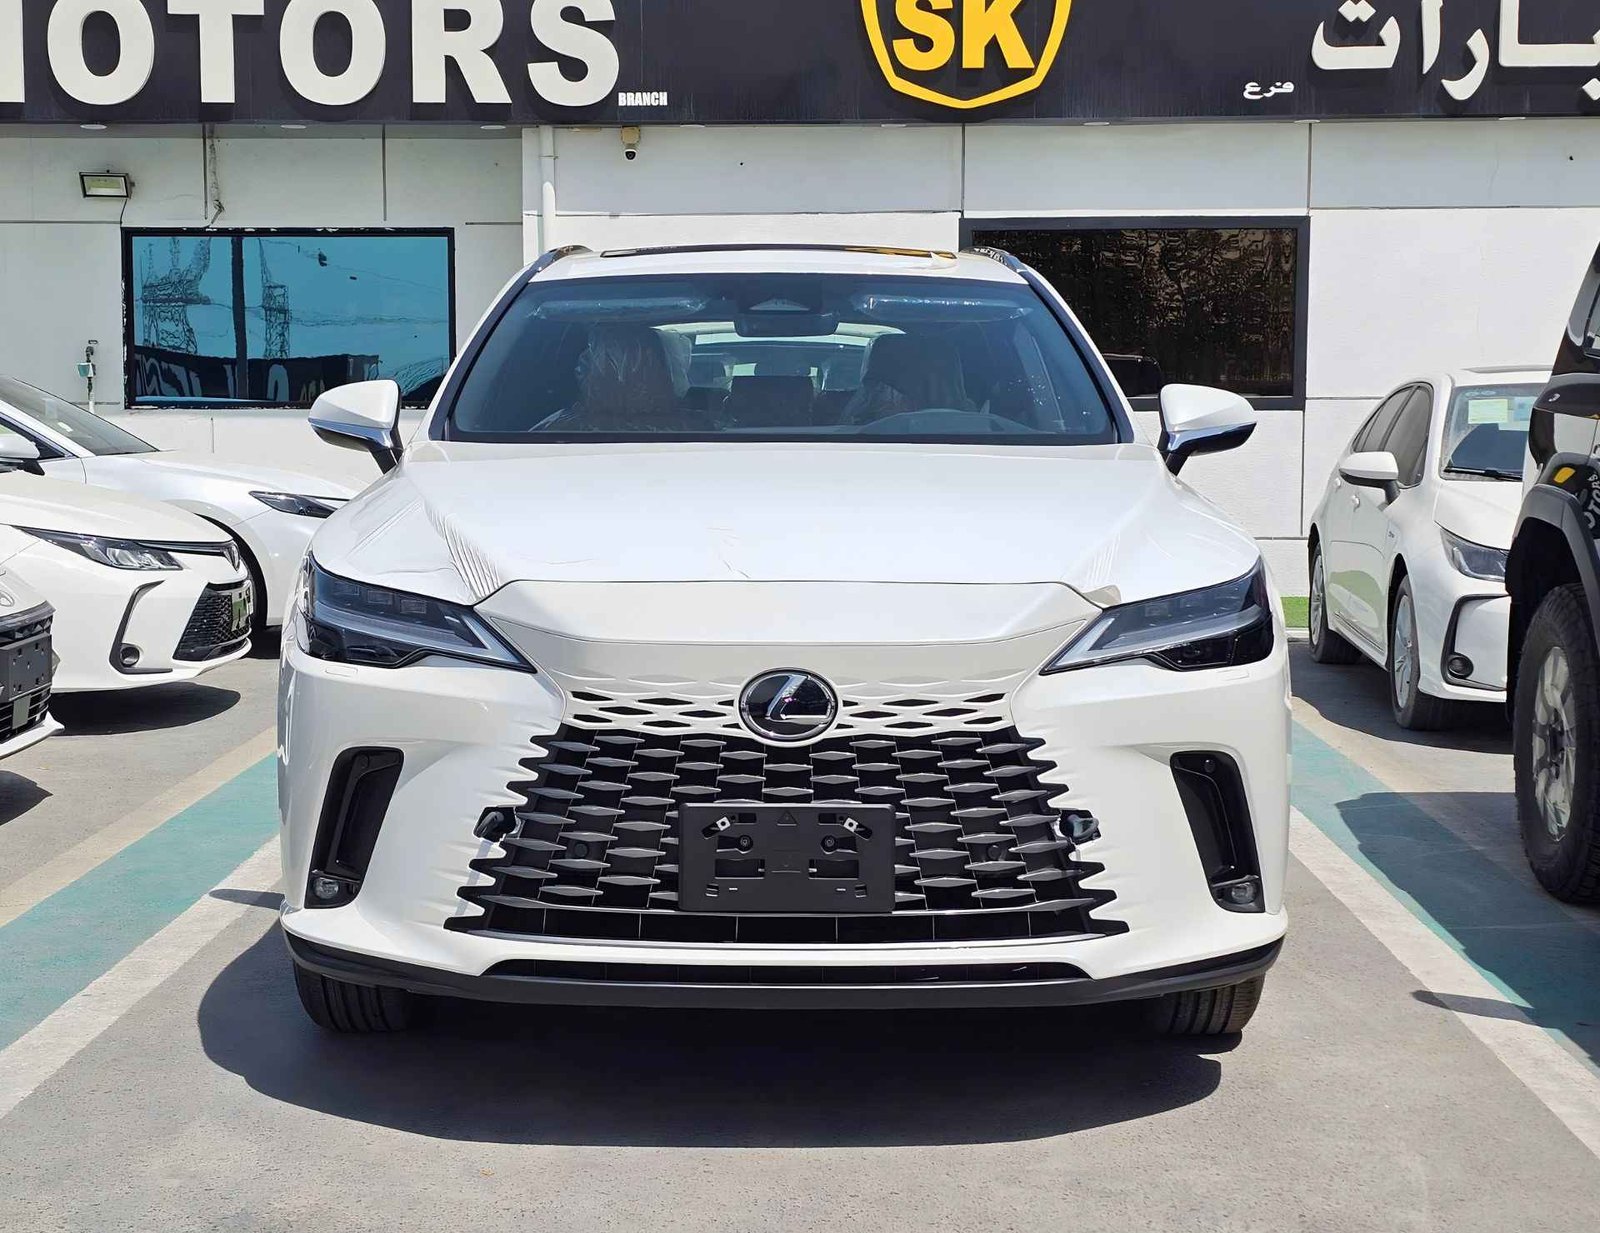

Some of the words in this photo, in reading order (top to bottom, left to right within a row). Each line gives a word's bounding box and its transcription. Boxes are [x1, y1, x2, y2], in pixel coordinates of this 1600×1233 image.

[0, 0, 620, 106] OTORS
[892, 0, 1035, 71] SK
[618, 92, 668, 106] BRANCH
[1243, 82, 1294, 100] فرع
